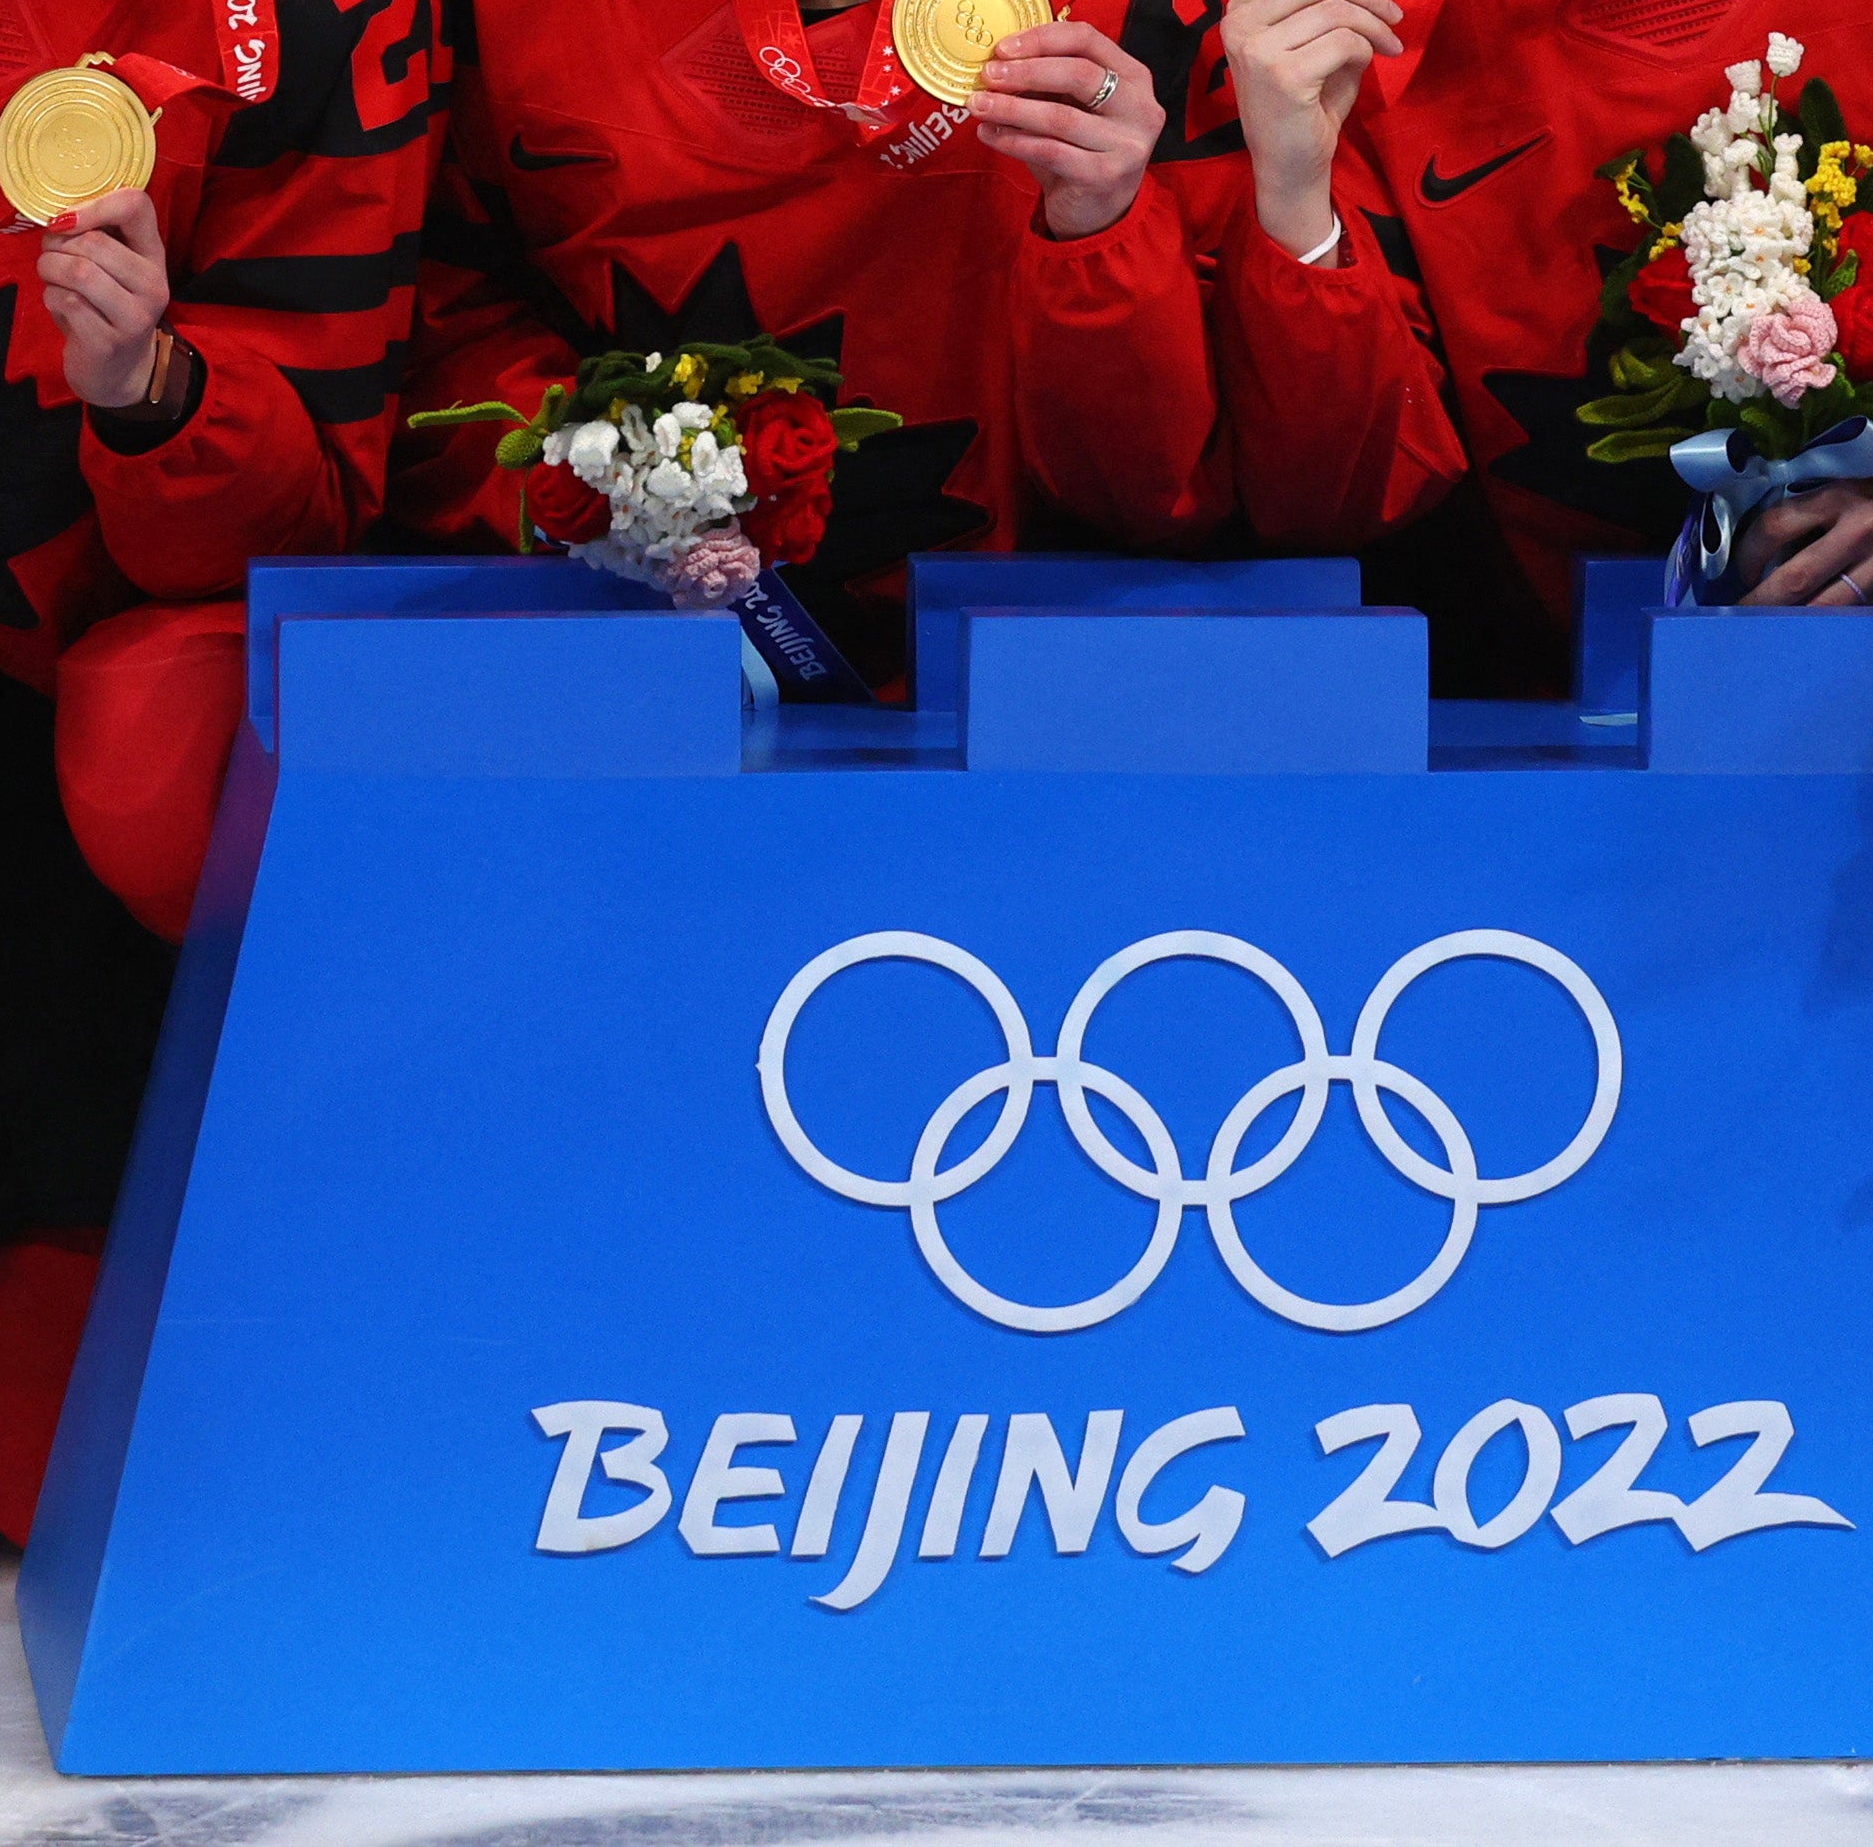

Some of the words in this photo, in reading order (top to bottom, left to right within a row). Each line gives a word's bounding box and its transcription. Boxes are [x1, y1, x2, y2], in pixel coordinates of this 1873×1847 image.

[755, 604, 828, 681] BEIJING
[530, 1398, 1247, 1612] BEIJING
[1305, 1392, 1859, 1559] 2022
